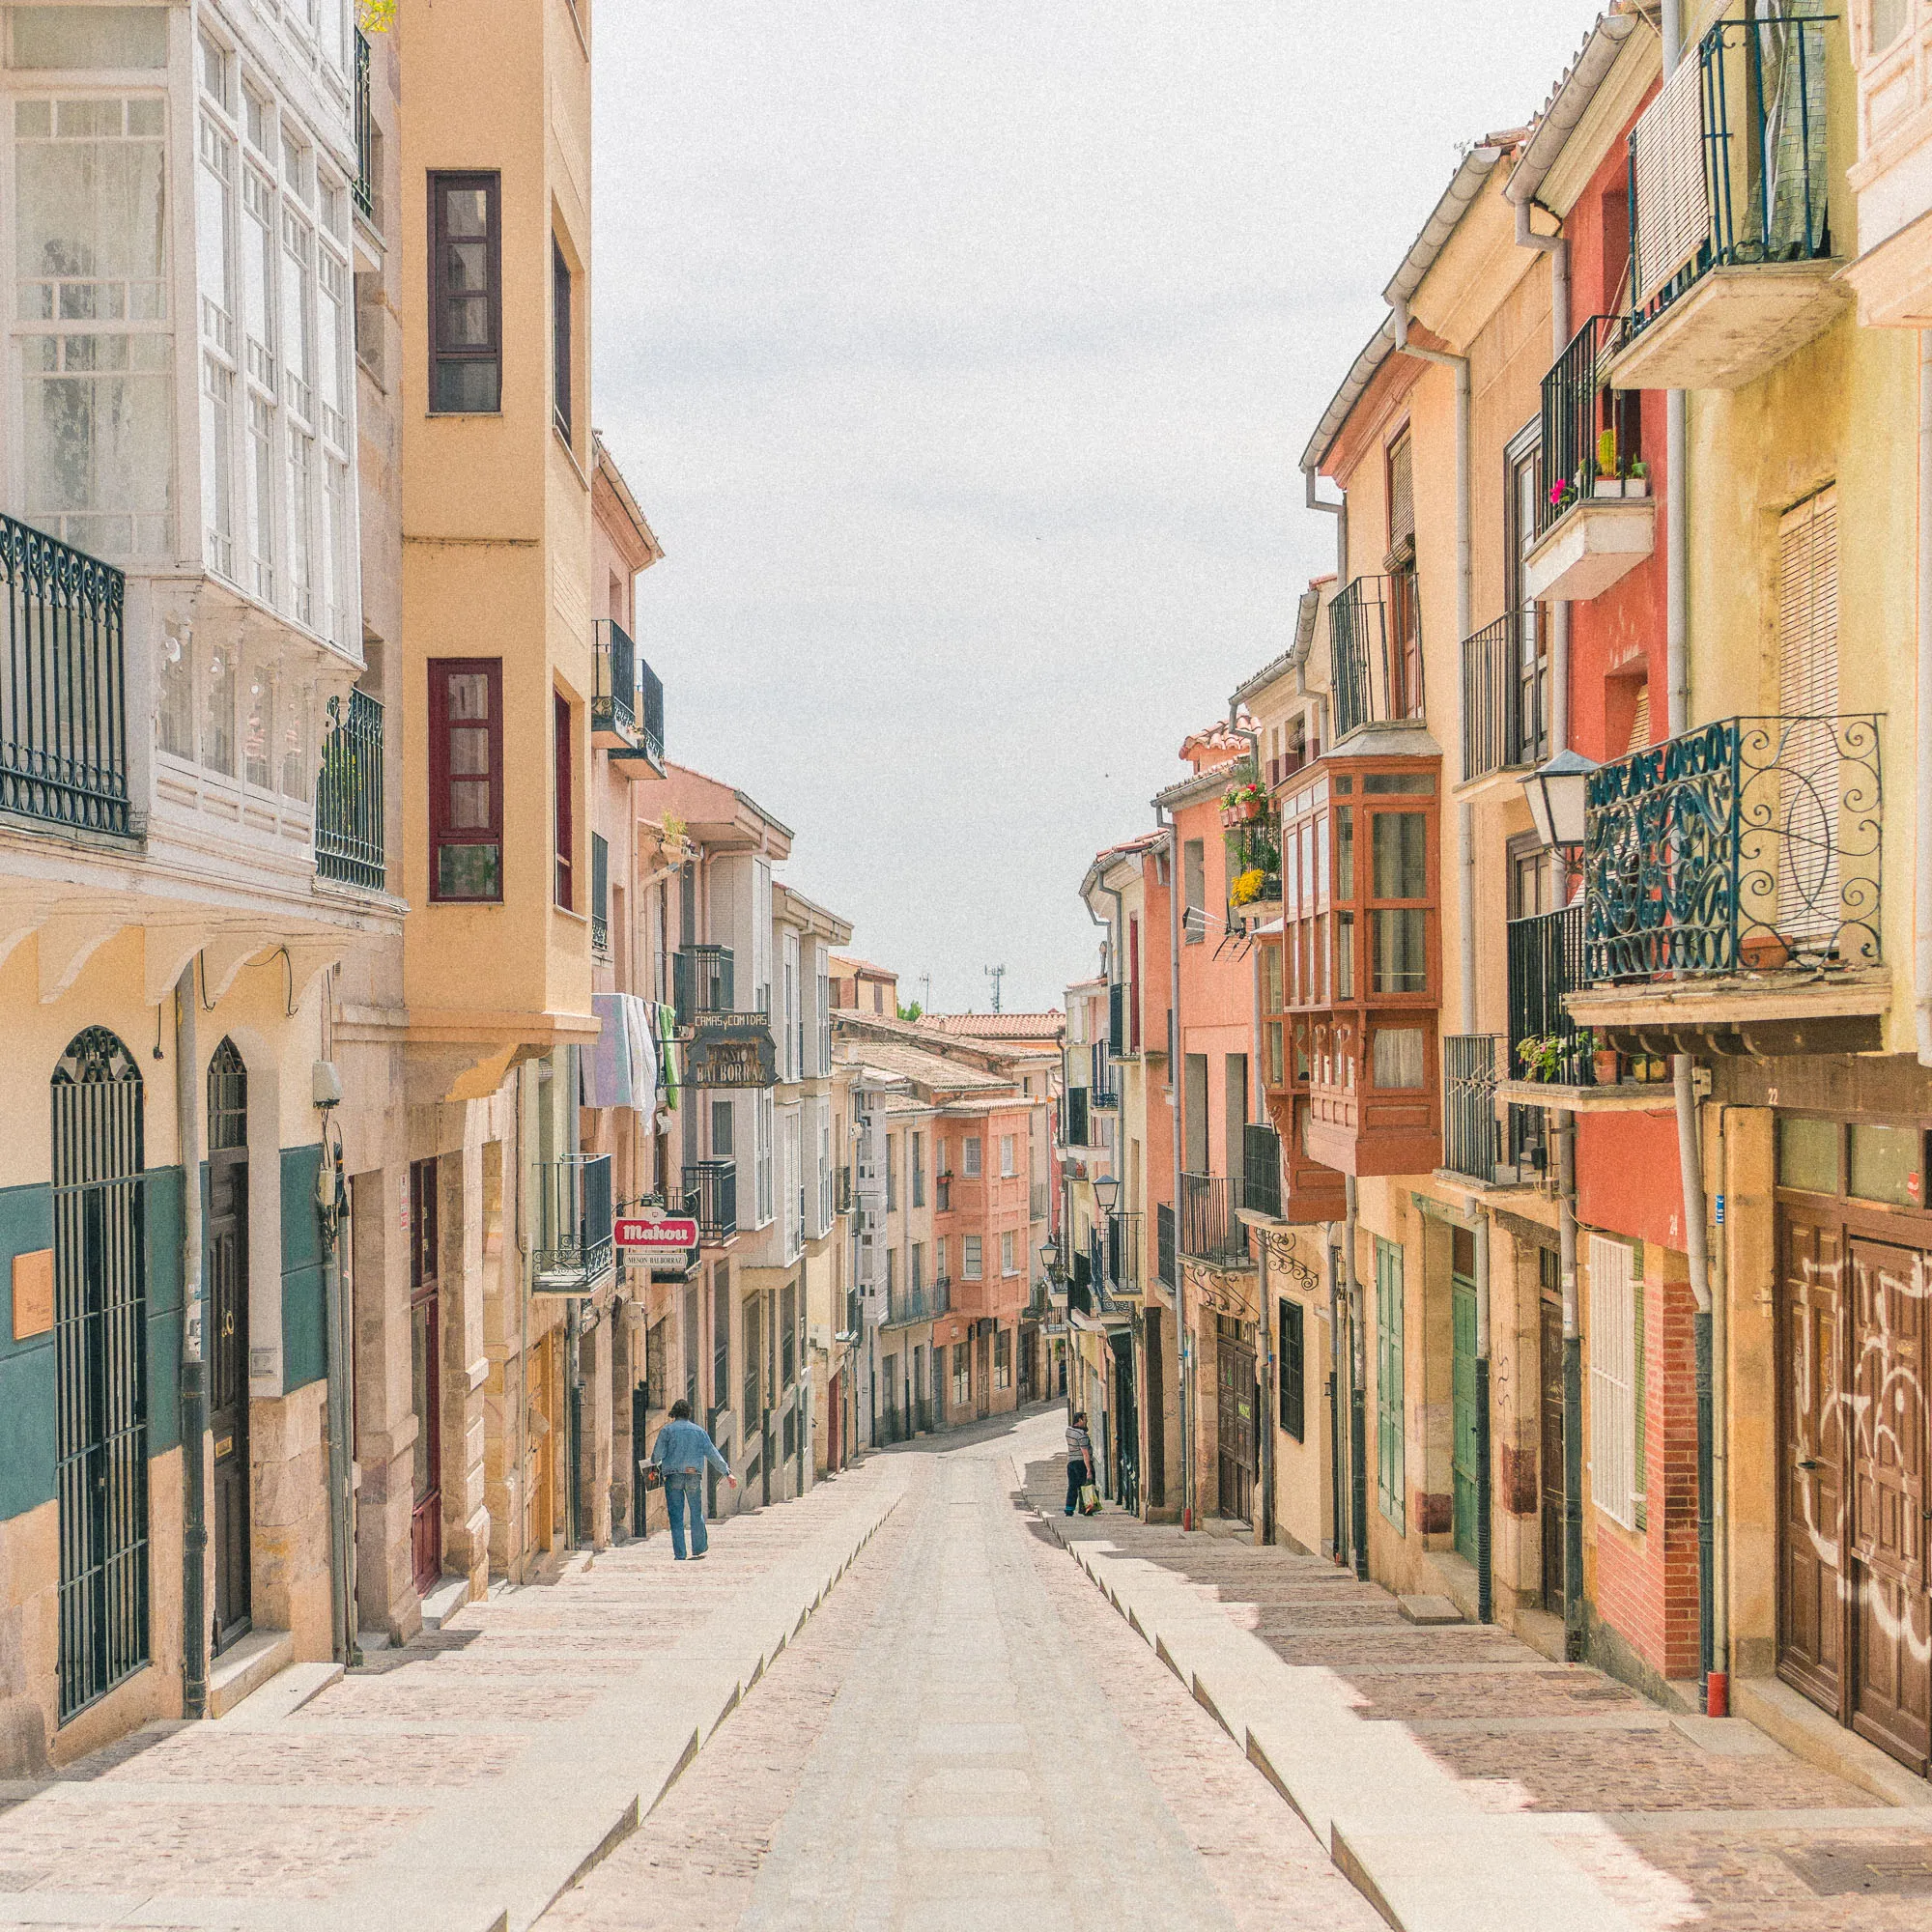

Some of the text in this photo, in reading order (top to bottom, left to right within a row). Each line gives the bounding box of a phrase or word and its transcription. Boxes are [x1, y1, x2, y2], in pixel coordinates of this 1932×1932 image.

[696, 1015, 723, 1026] CAMAS
[728, 1014, 767, 1026] COMIDAS
[1768, 1088, 1778, 1105] 22
[623, 1225, 689, 1241] Mahou
